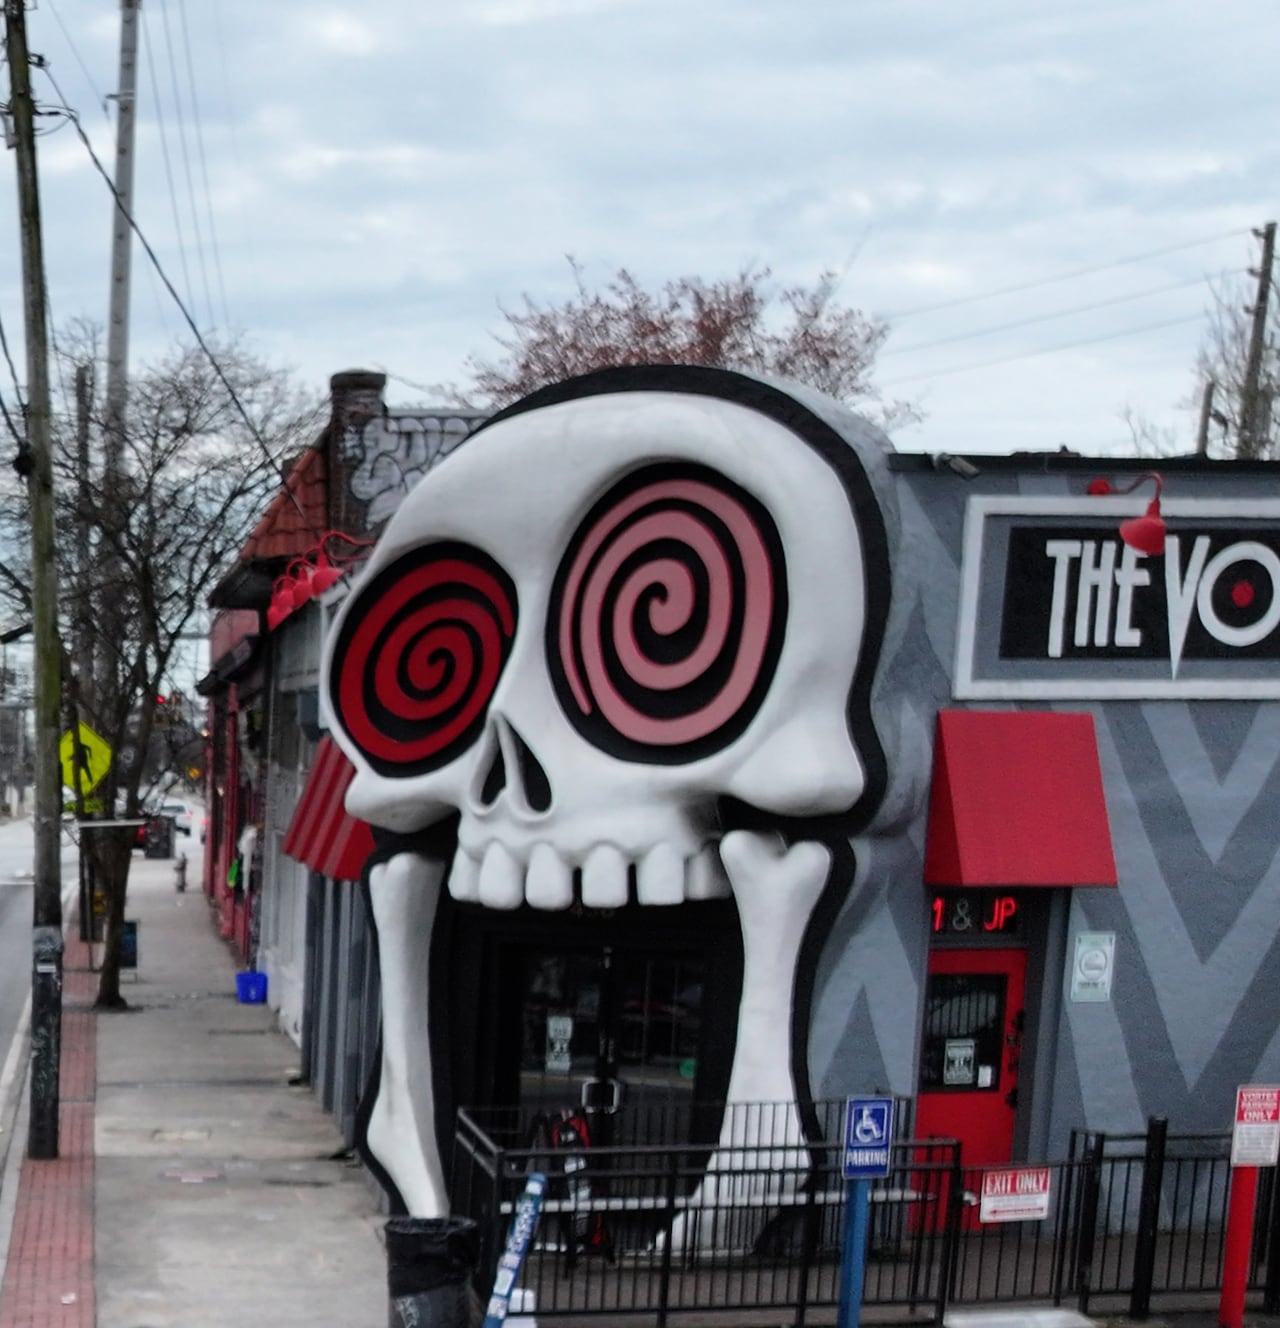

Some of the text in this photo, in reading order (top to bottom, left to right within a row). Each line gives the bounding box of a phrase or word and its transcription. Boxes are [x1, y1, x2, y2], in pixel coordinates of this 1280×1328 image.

[1045, 535, 1280, 681] THE VO
[983, 896, 1017, 932] JP
[845, 1150, 888, 1167] PARKING
[985, 1170, 1048, 1195] EXIT ONLY
